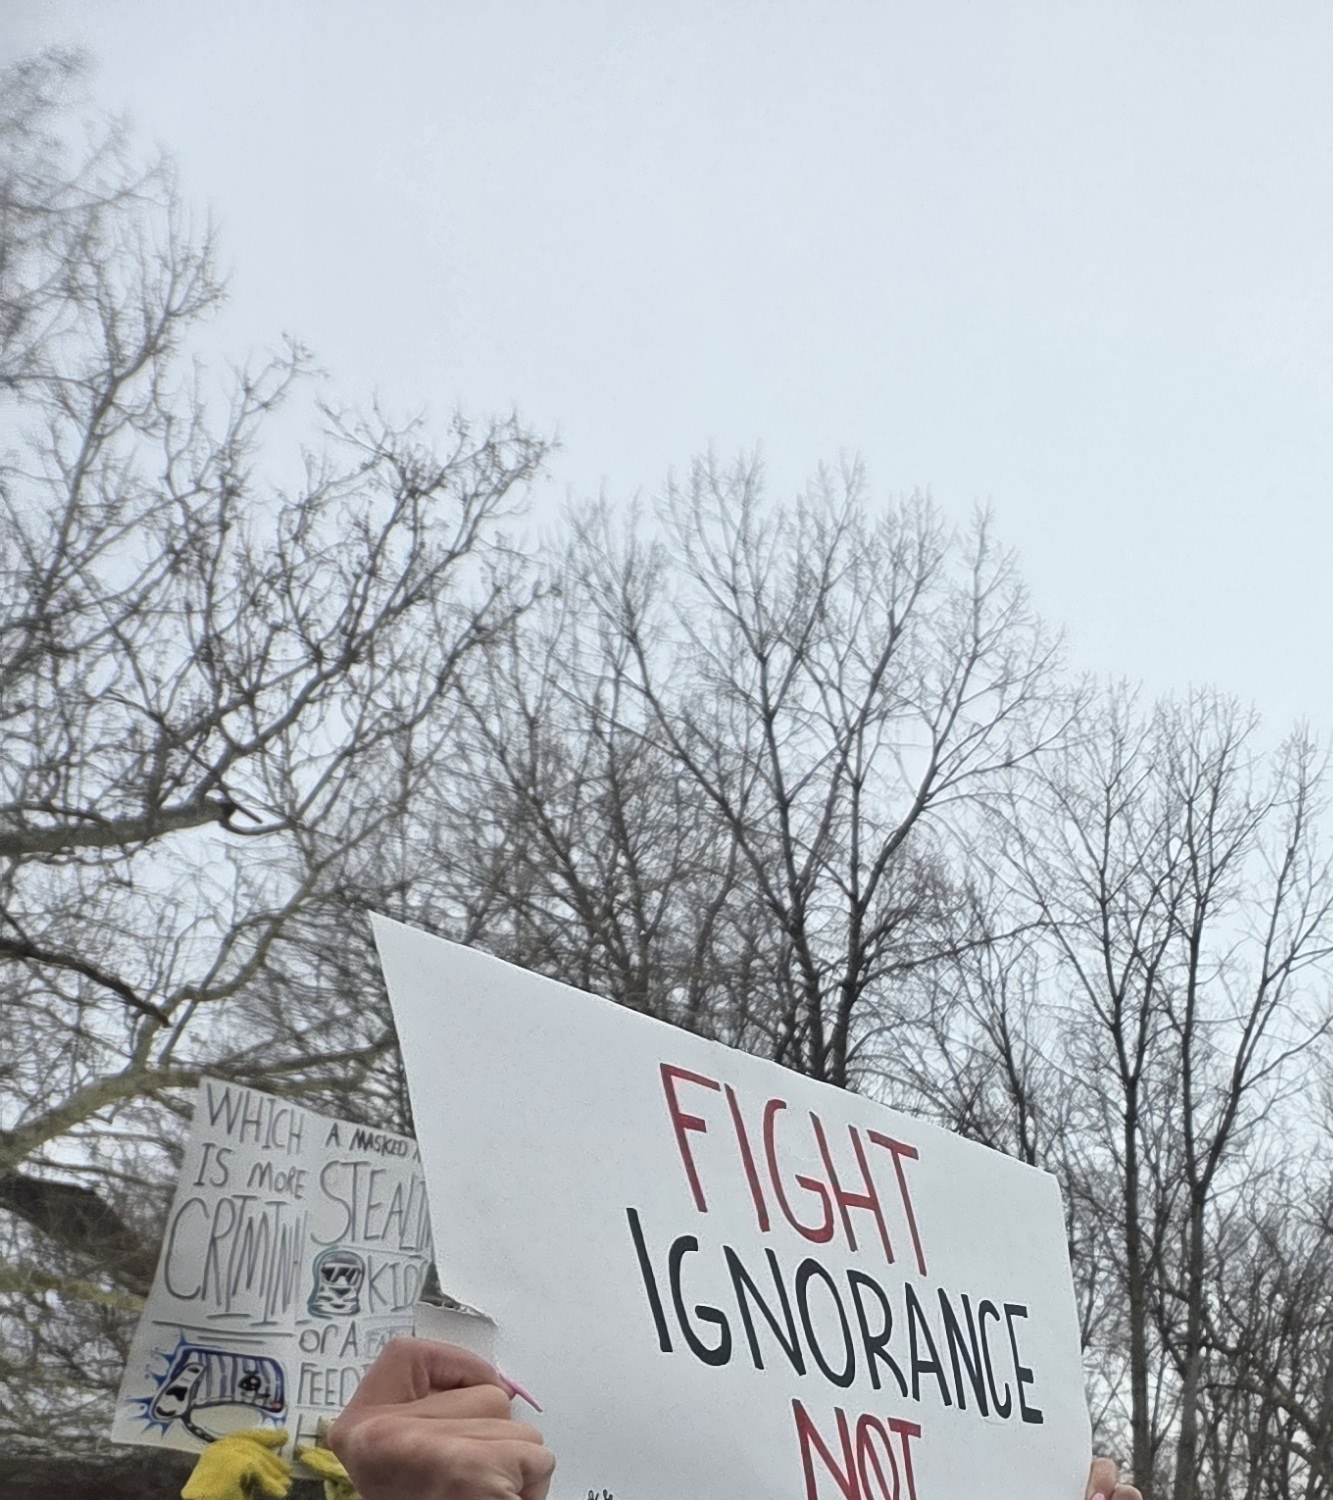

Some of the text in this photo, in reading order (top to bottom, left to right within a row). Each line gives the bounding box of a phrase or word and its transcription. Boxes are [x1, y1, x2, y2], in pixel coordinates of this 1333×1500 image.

[206, 1082, 304, 1156] WHICH
[325, 1122, 341, 1148] A
[193, 1142, 307, 1199] IS MORE
[659, 1063, 928, 1277] FIGHT
[626, 1207, 1044, 1425] IGNORANCE
